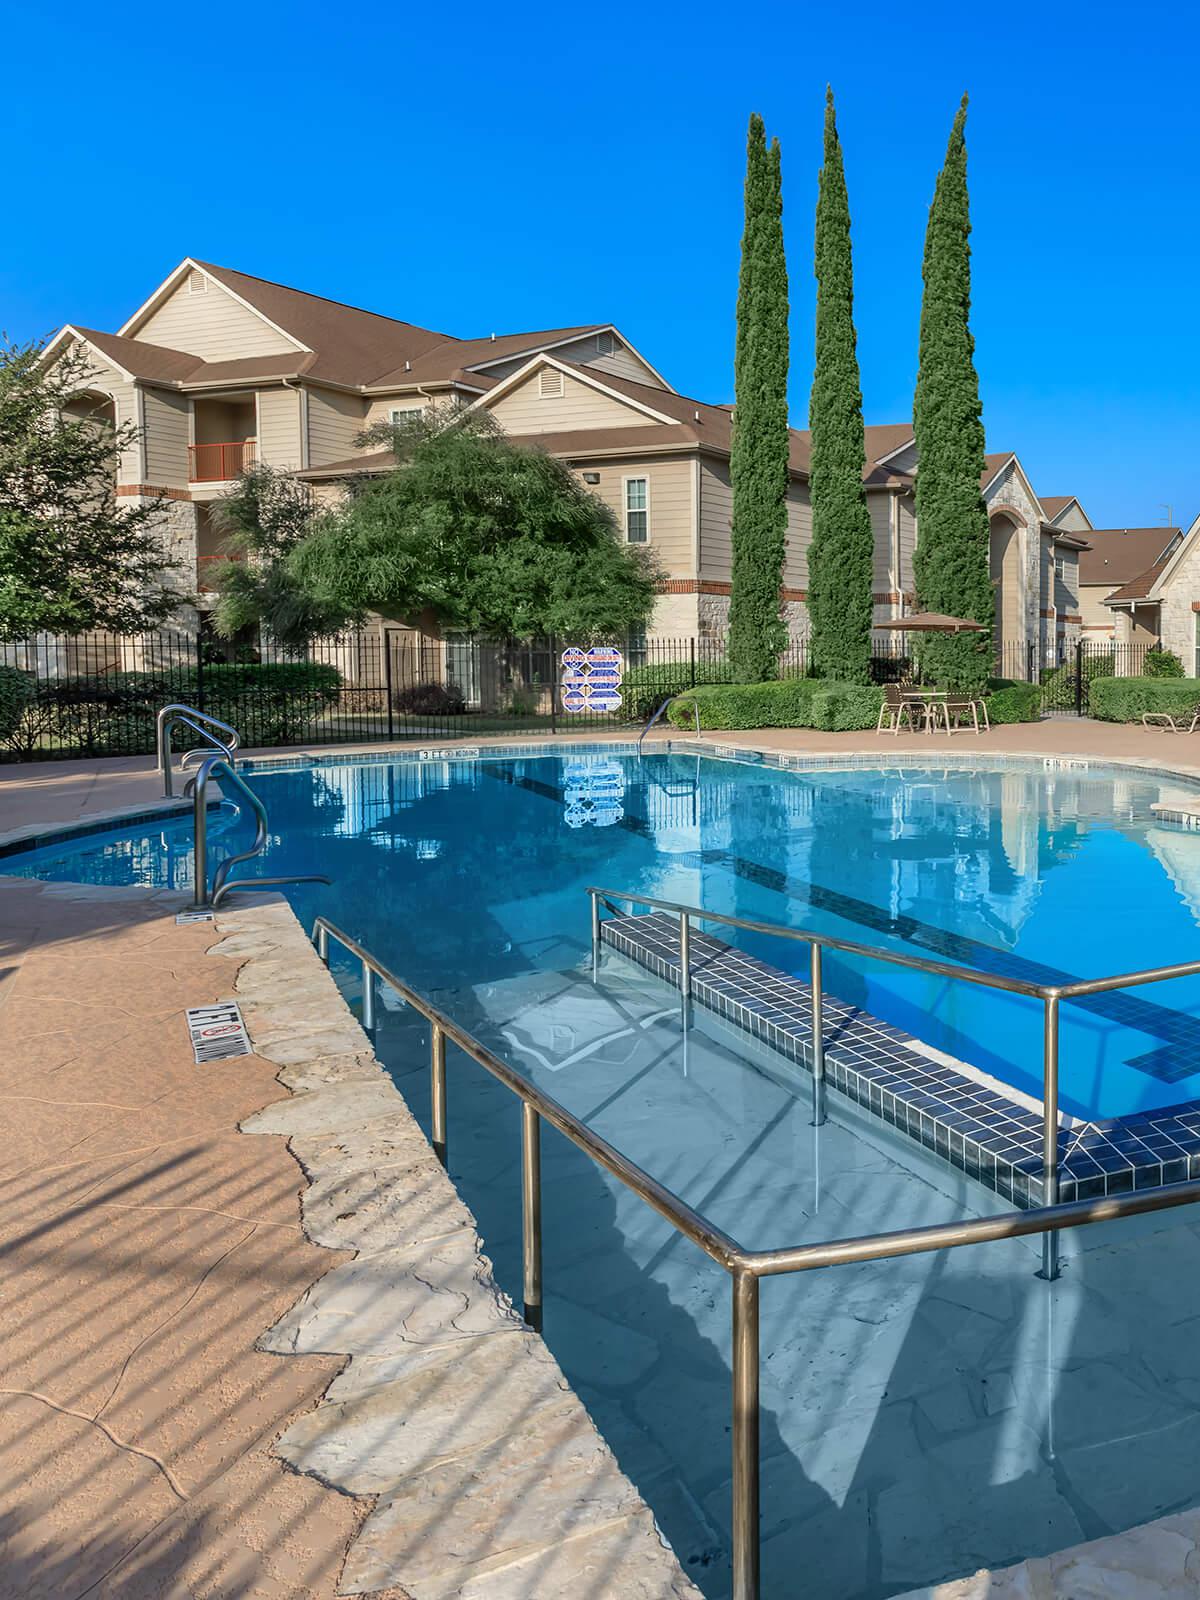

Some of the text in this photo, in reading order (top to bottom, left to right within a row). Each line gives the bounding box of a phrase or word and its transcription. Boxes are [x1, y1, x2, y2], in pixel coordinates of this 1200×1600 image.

[423, 751, 429, 759] 3
[189, 1004, 235, 1015] 2
[190, 1012, 239, 1027] FT
